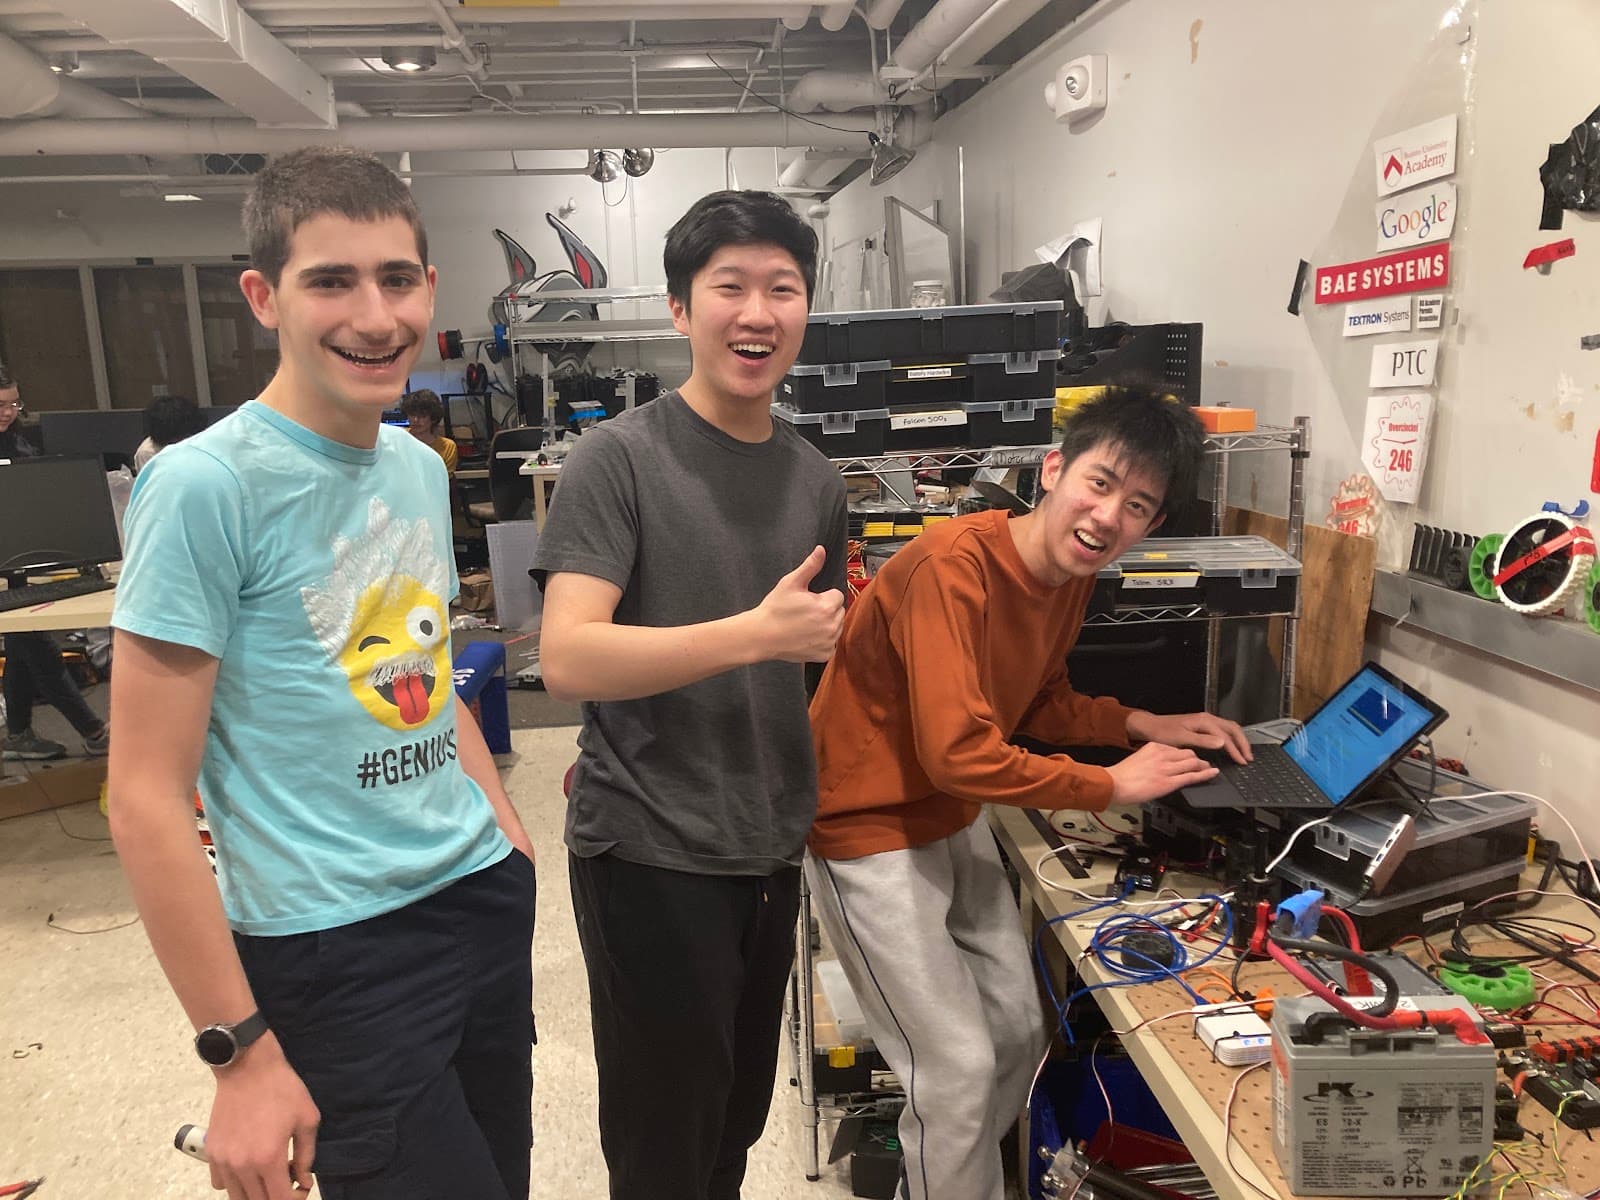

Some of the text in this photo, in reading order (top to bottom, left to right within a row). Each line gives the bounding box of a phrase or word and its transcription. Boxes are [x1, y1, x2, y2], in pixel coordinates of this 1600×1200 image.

[1404, 153, 1448, 175] Academy
[1380, 194, 1448, 239] Google
[1320, 254, 1444, 296] BAE SYSTEMS
[1348, 312, 1382, 327] TEXTRON
[1383, 310, 1410, 325] Systems
[1392, 349, 1427, 376] PTC
[1388, 448, 1414, 473] 246
[357, 728, 457, 789] #GENIUS
[1403, 1175, 1428, 1189] Pb
